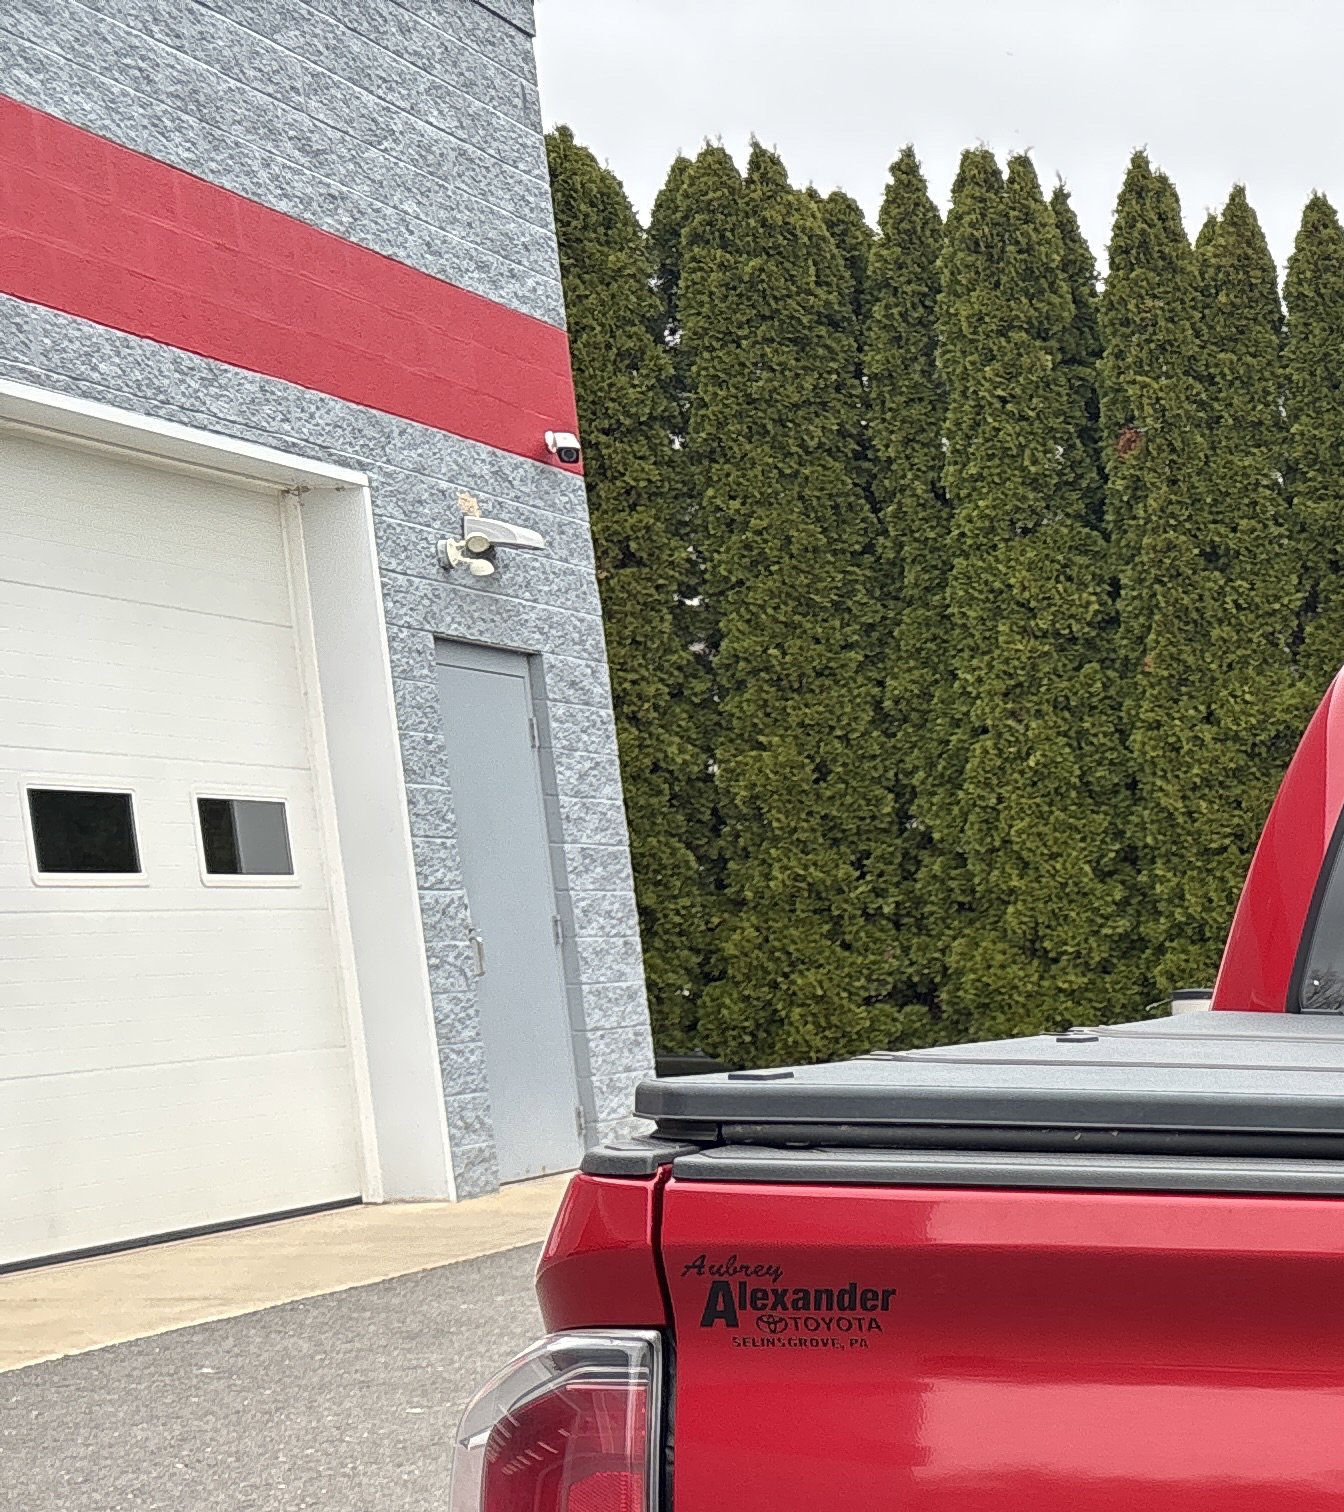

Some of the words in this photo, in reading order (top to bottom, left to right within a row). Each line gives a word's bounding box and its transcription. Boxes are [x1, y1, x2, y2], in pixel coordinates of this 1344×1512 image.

[681, 1254, 783, 1282] Aubrey
[700, 1280, 896, 1328] Alexander
[792, 1316, 882, 1333] TOYOTA
[850, 1337, 868, 1348] PA
